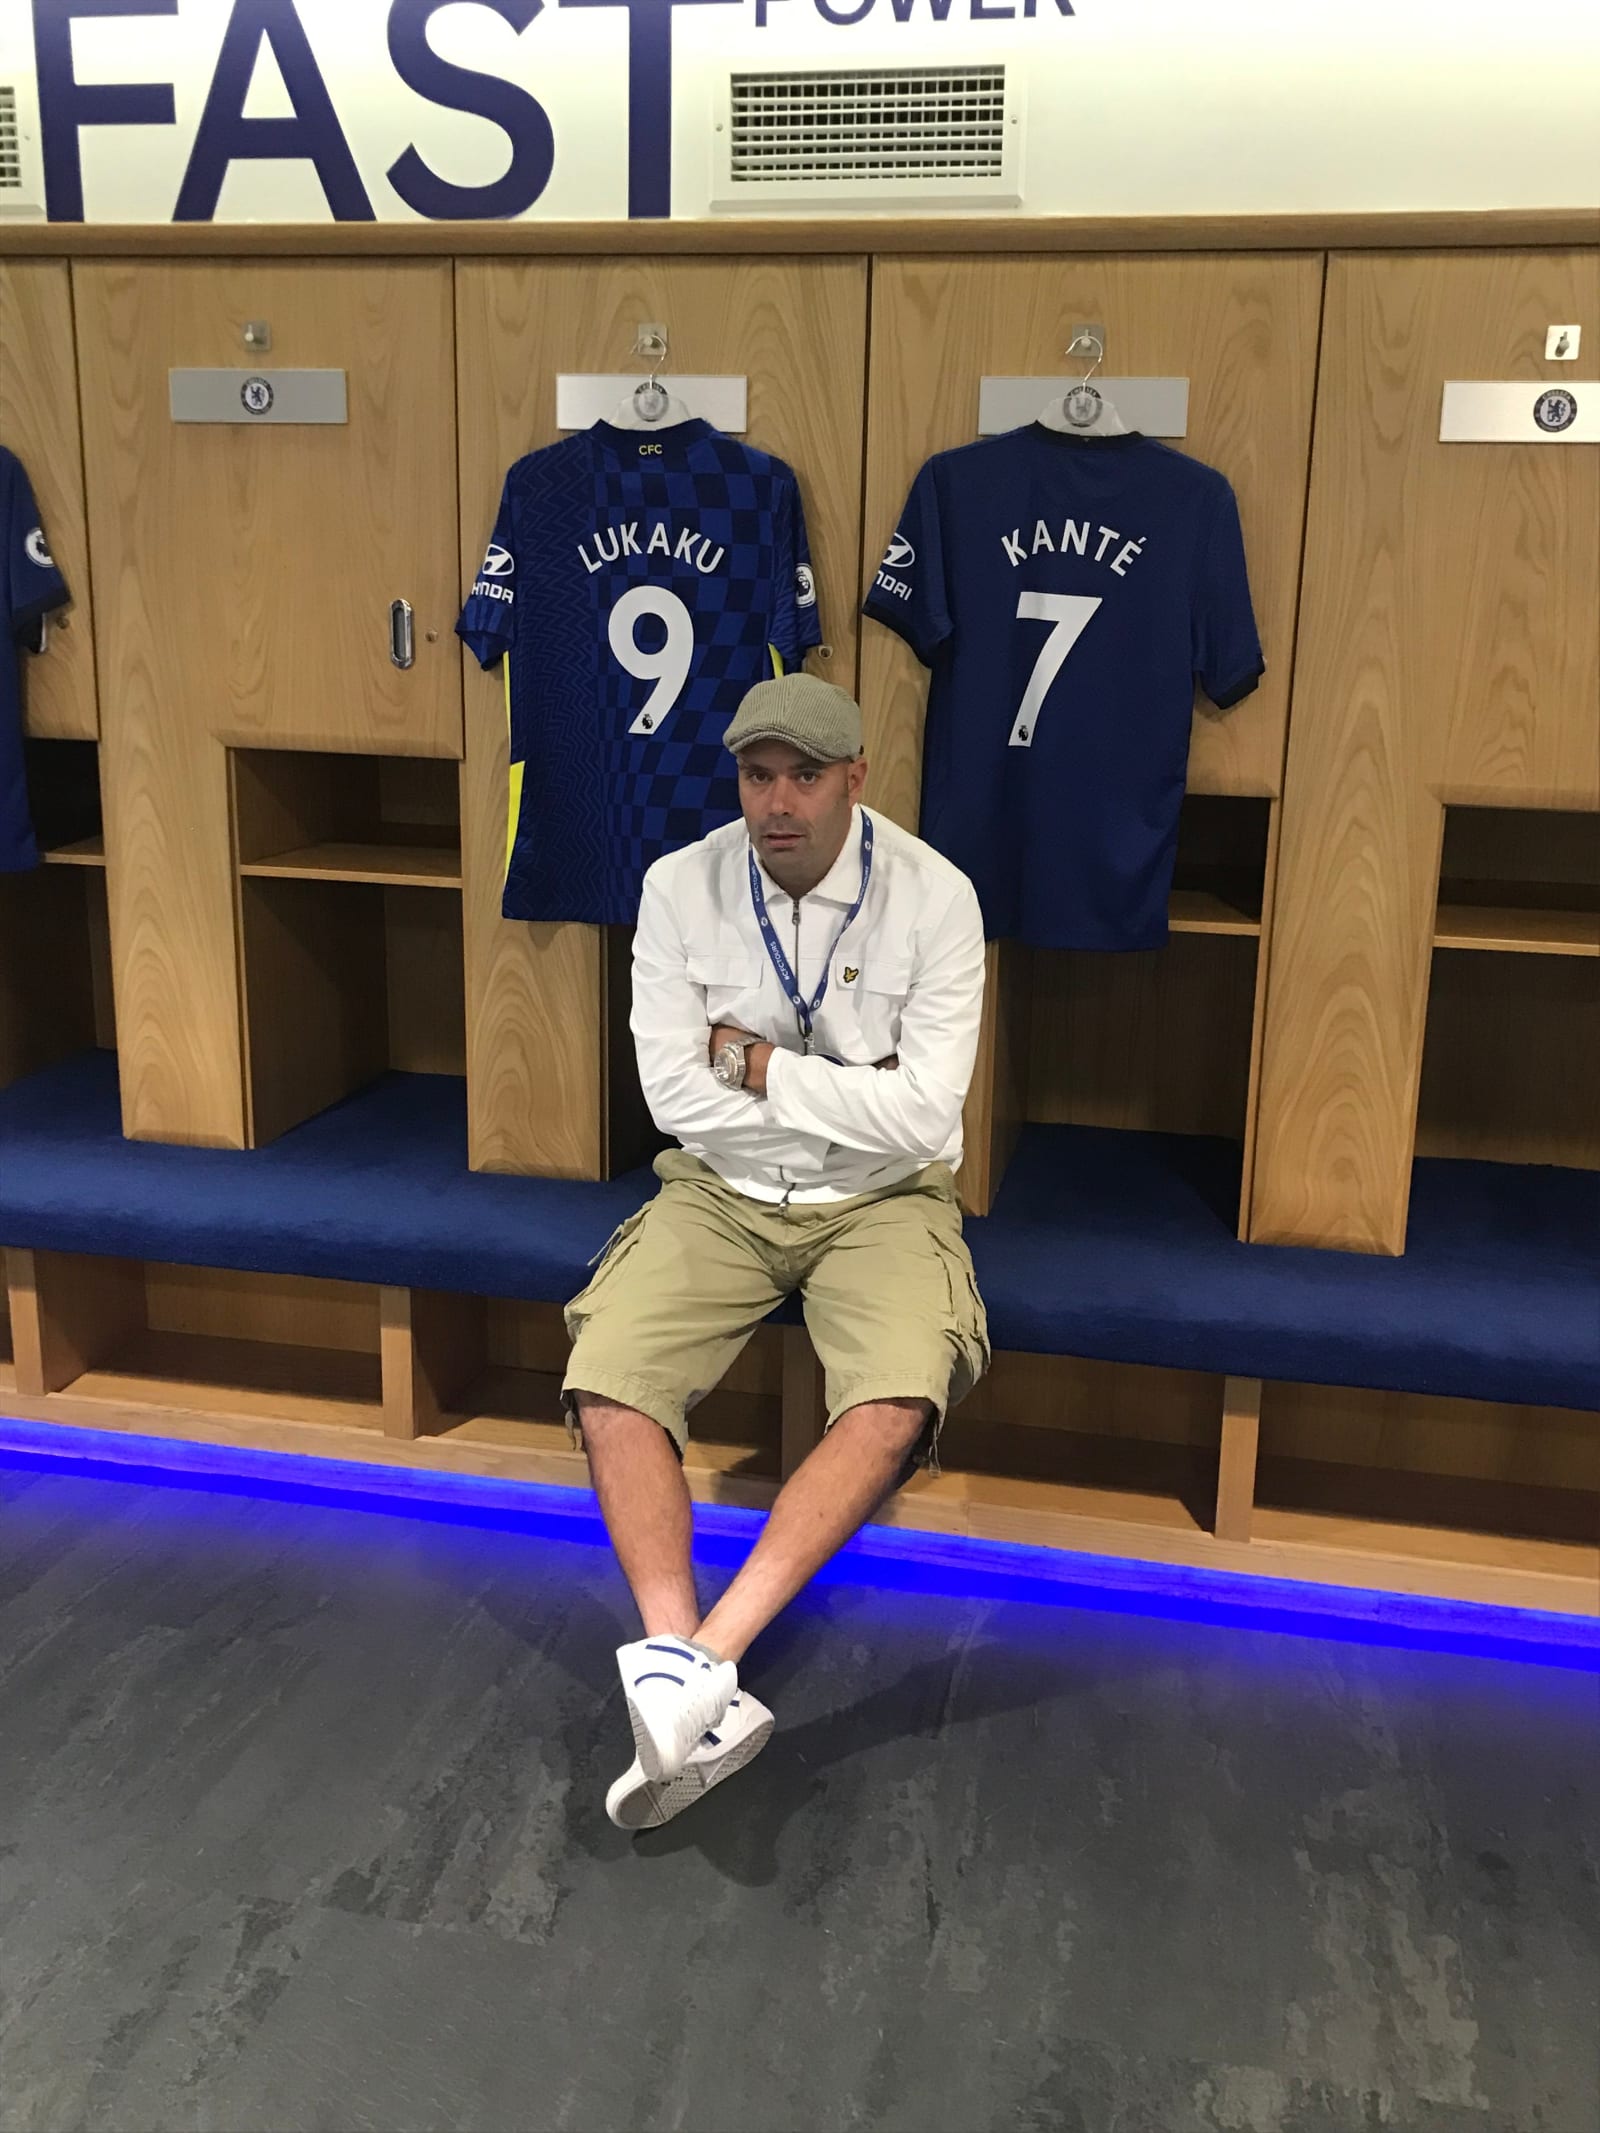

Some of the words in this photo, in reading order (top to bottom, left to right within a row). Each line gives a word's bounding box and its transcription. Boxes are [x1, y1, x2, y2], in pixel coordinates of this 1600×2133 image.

[32, 0, 744, 223] FAST
[638, 444, 663, 456] CFC
[577, 522, 725, 574] LUKAKU
[1001, 519, 1147, 577] KANTÉ
[608, 585, 694, 735] 9
[1008, 591, 1103, 748] 7
